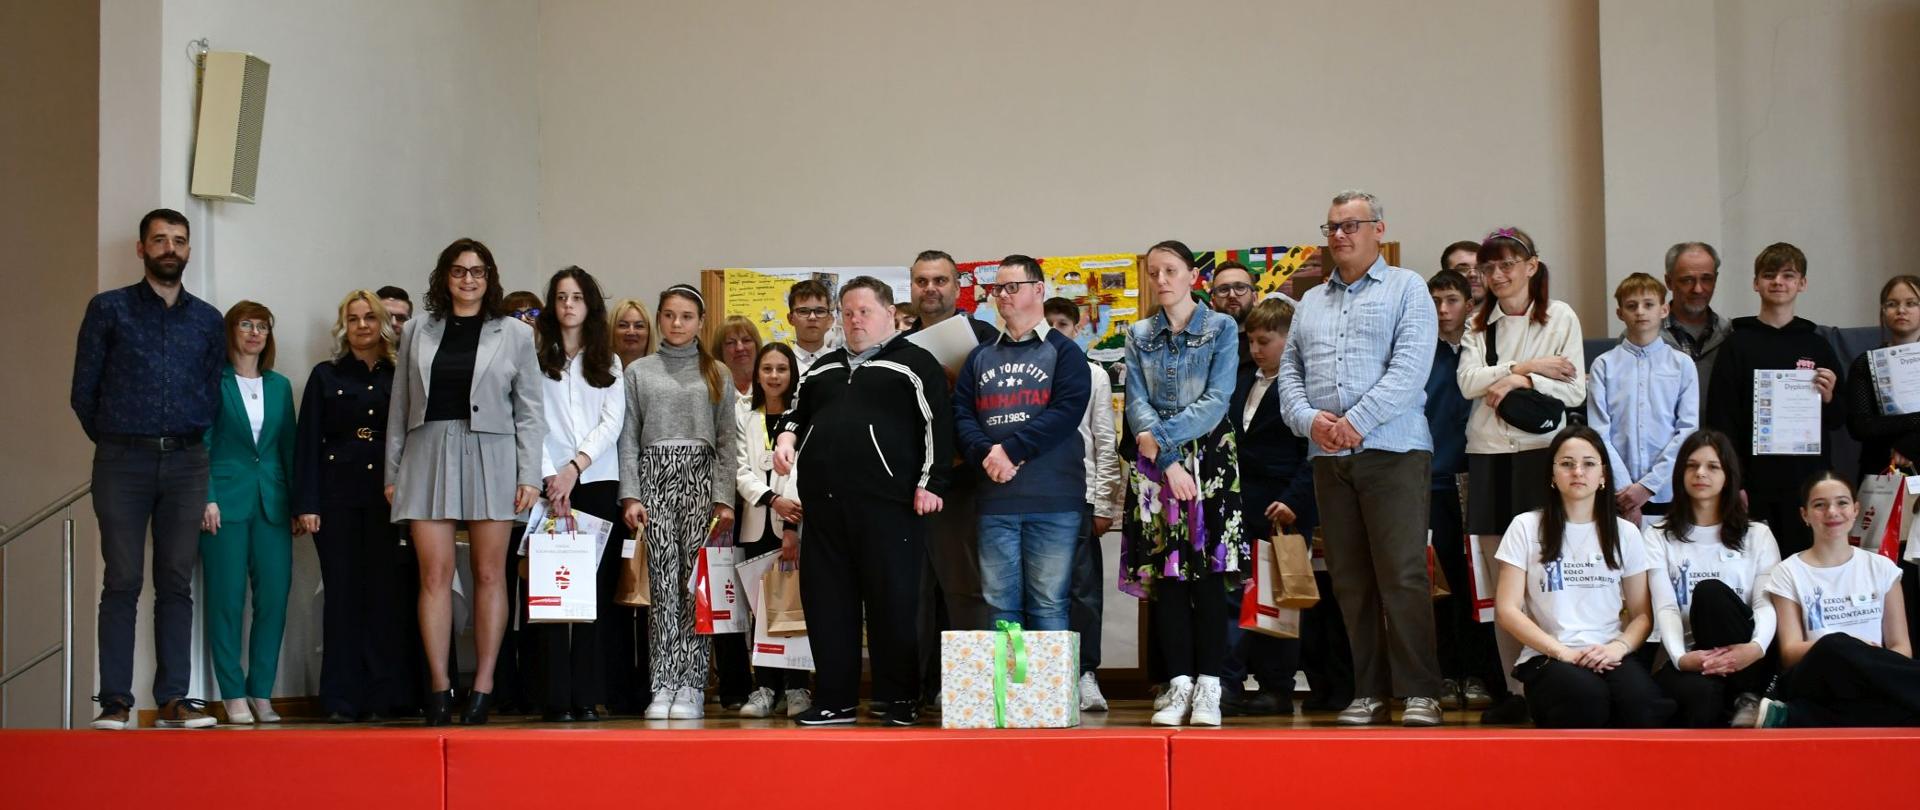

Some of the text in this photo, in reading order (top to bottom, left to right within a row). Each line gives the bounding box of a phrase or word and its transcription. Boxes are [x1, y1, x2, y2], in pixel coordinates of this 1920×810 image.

[979, 363, 1049, 389] NEW YORK CITY
[1824, 605, 1845, 613] KOŁO
